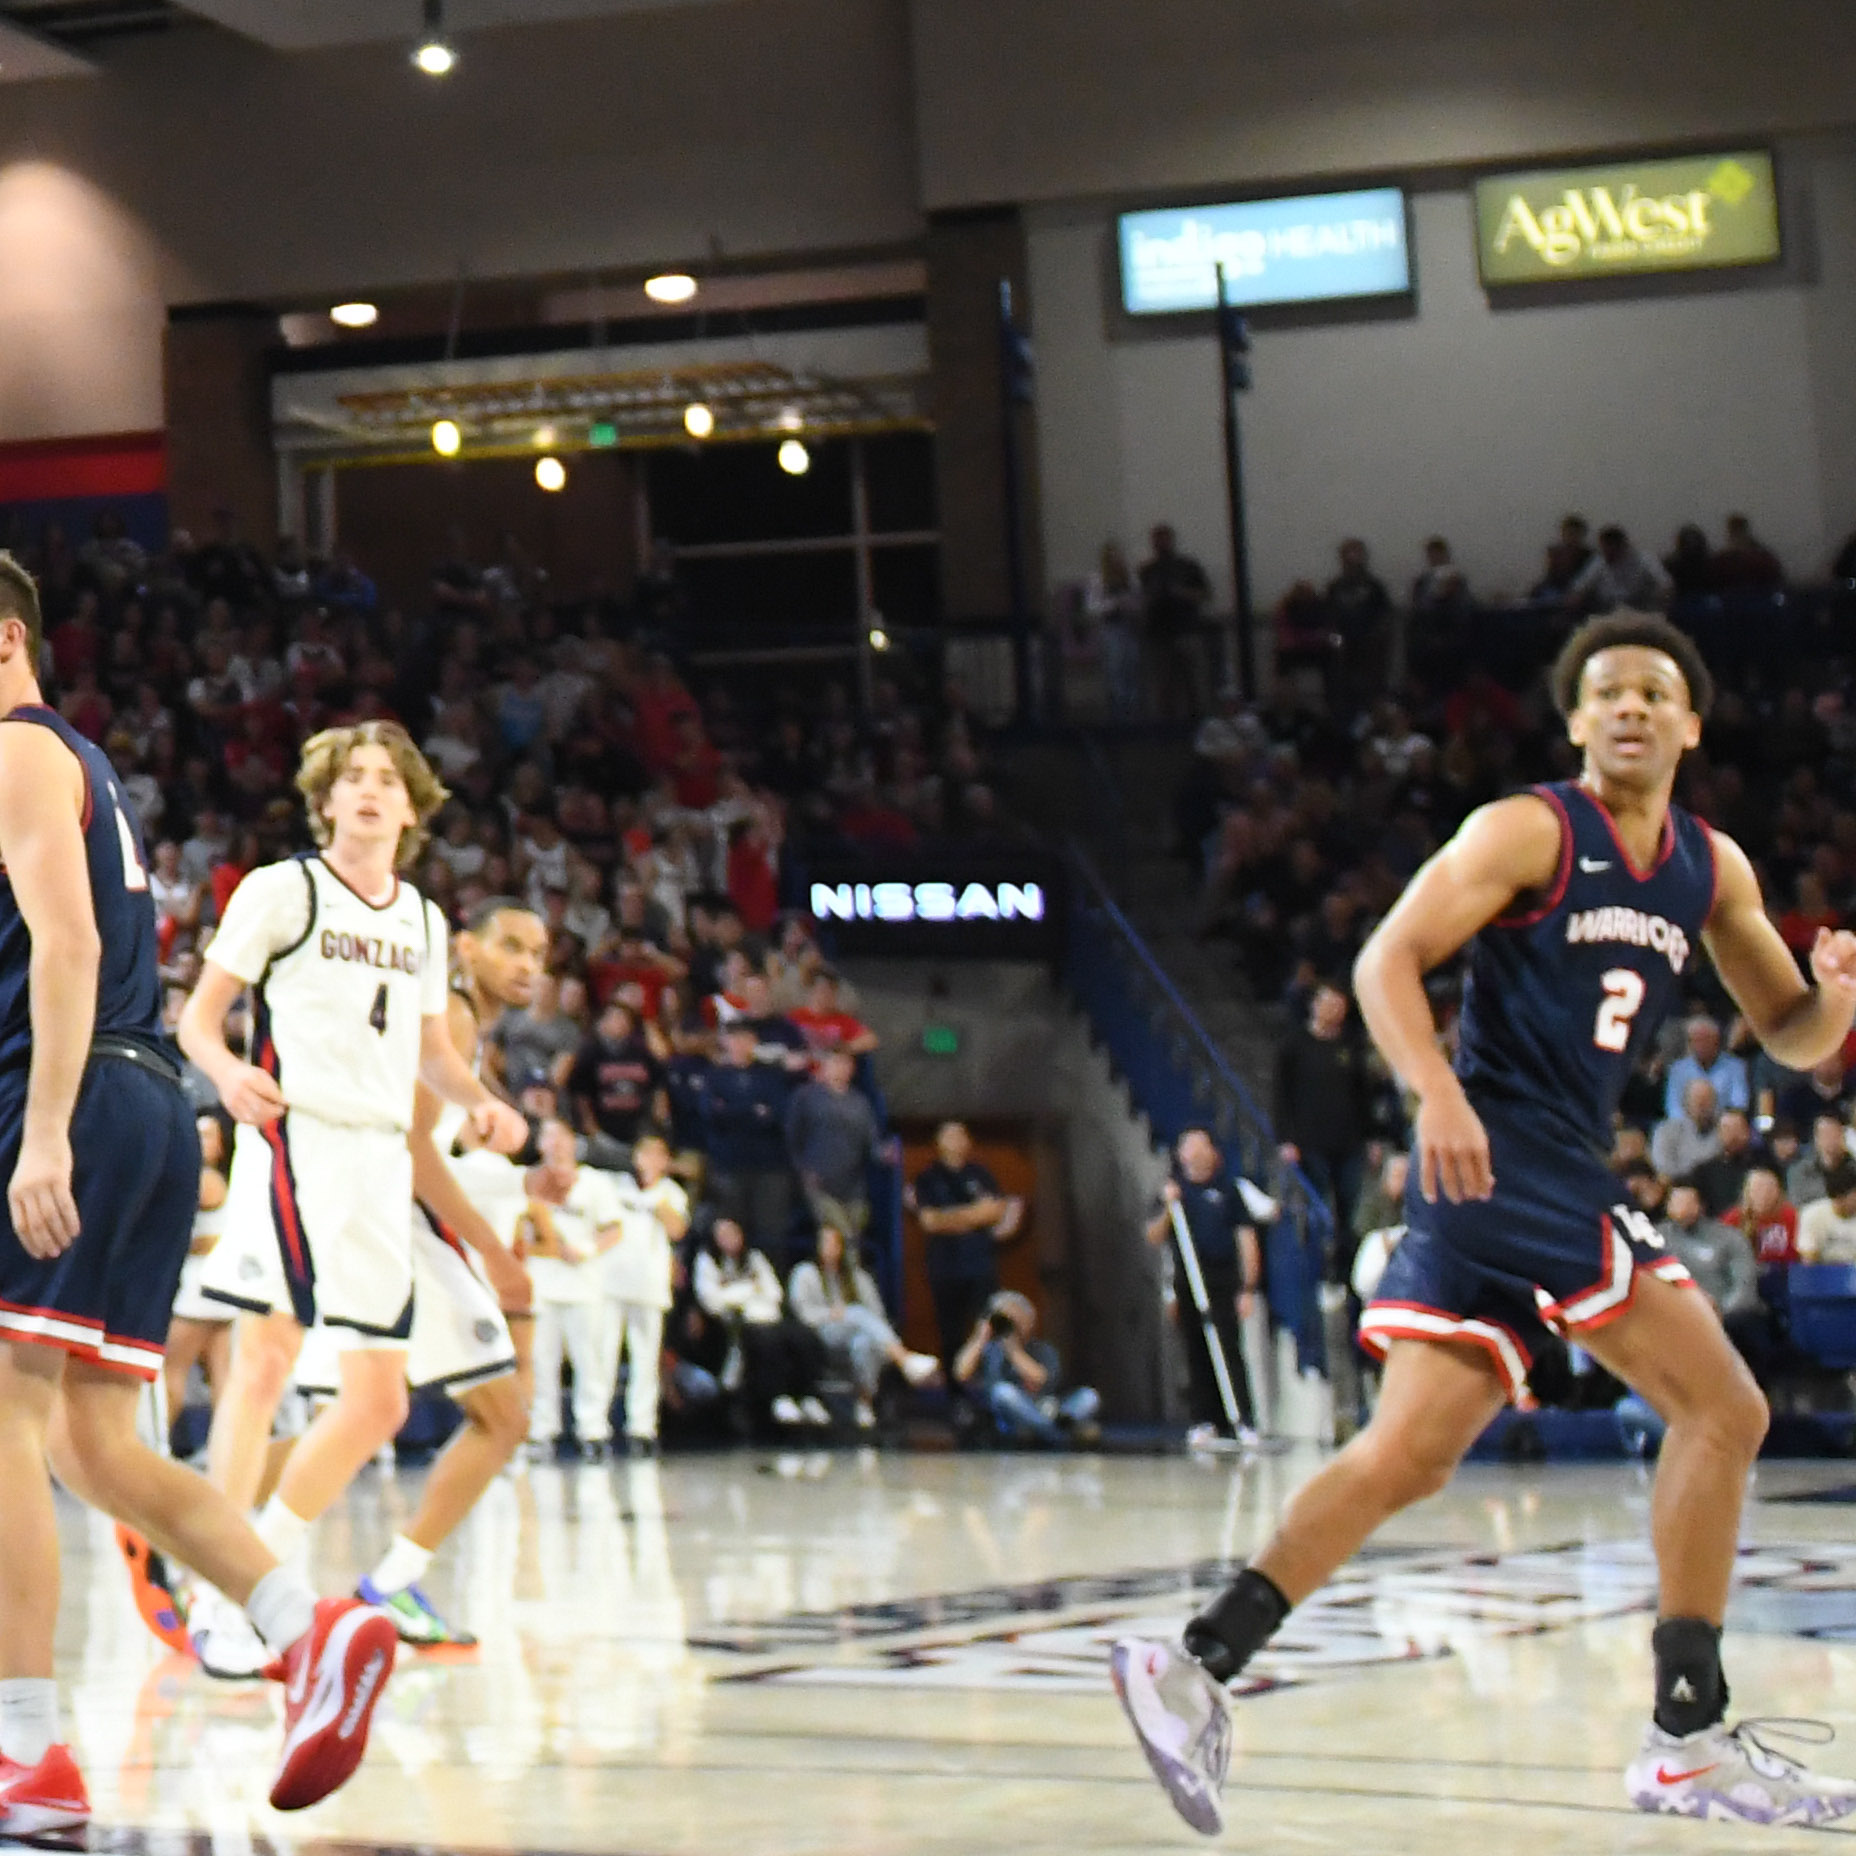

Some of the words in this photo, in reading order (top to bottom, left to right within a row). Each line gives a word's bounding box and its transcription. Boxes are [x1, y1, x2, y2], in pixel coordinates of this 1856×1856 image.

[1494, 182, 1711, 267] AgWest
[809, 881, 1044, 923] NISSAN
[320, 928, 418, 977] GONZAG
[1593, 966, 1648, 1055] 2
